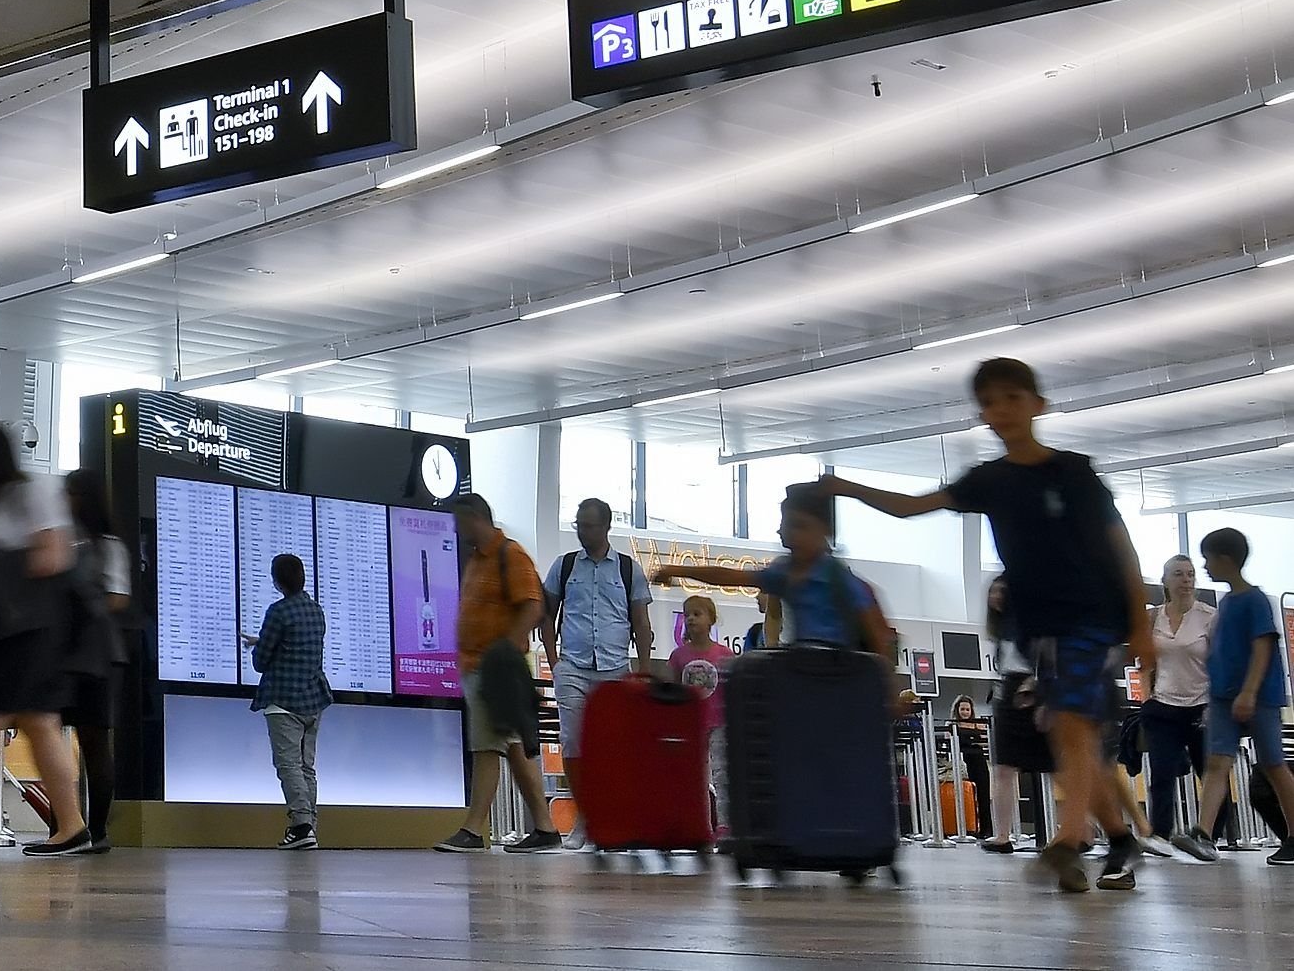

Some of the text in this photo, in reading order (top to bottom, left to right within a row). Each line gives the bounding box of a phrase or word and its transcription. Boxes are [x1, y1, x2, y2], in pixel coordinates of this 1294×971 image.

[689, 1, 706, 11] TAX
[212, 78, 290, 111] Terminal 1
[213, 103, 279, 132] Check-in
[187, 418, 228, 441] Abflug
[187, 437, 251, 460] Departure
[190, 671, 206, 680] 11:00
